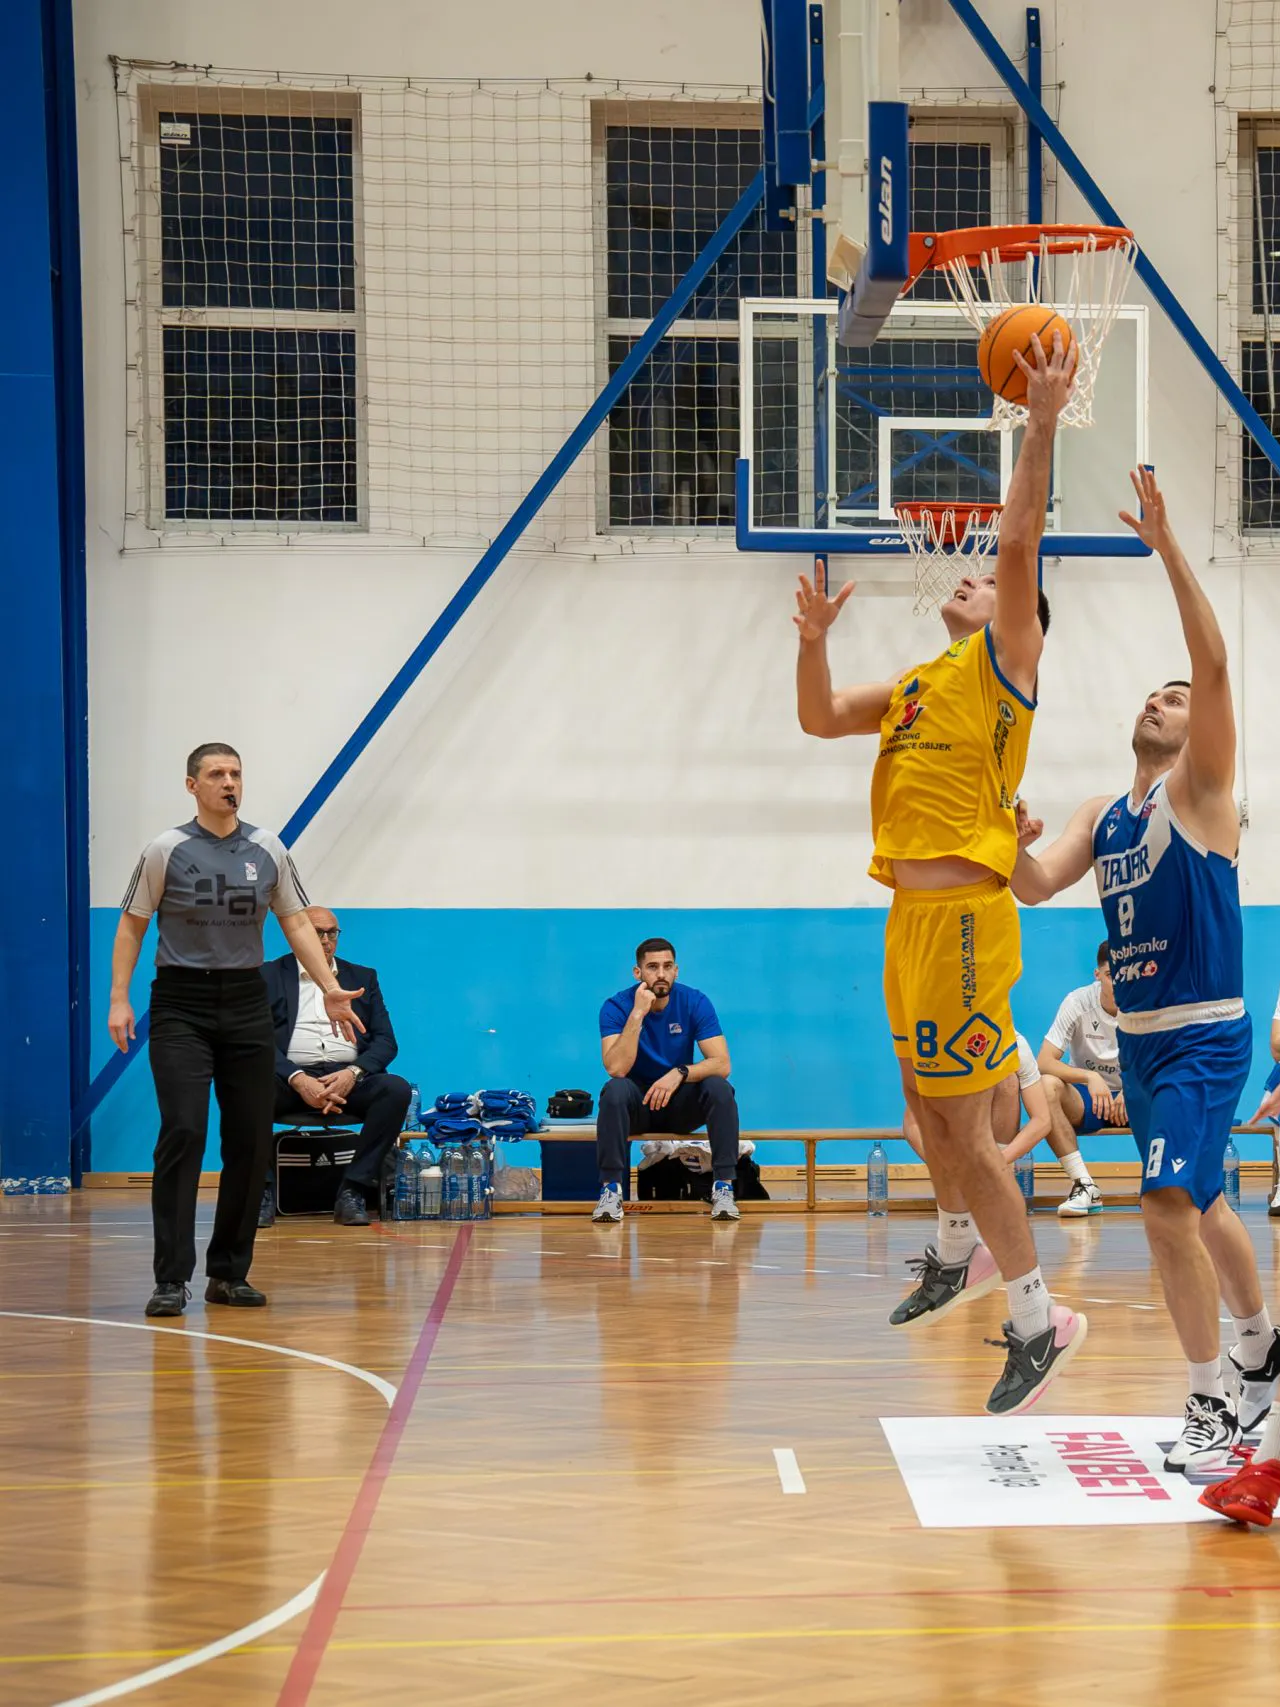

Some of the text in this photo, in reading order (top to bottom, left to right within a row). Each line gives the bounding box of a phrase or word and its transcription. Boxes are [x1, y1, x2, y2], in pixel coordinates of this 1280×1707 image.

[879, 156, 892, 245] elan
[919, 742, 952, 751] OSIJEK
[916, 1020, 938, 1058] 8
[949, 1220, 969, 1228] 23
[1023, 1279, 1041, 1295] 23
[1045, 1432, 1171, 1500] FAVBET
